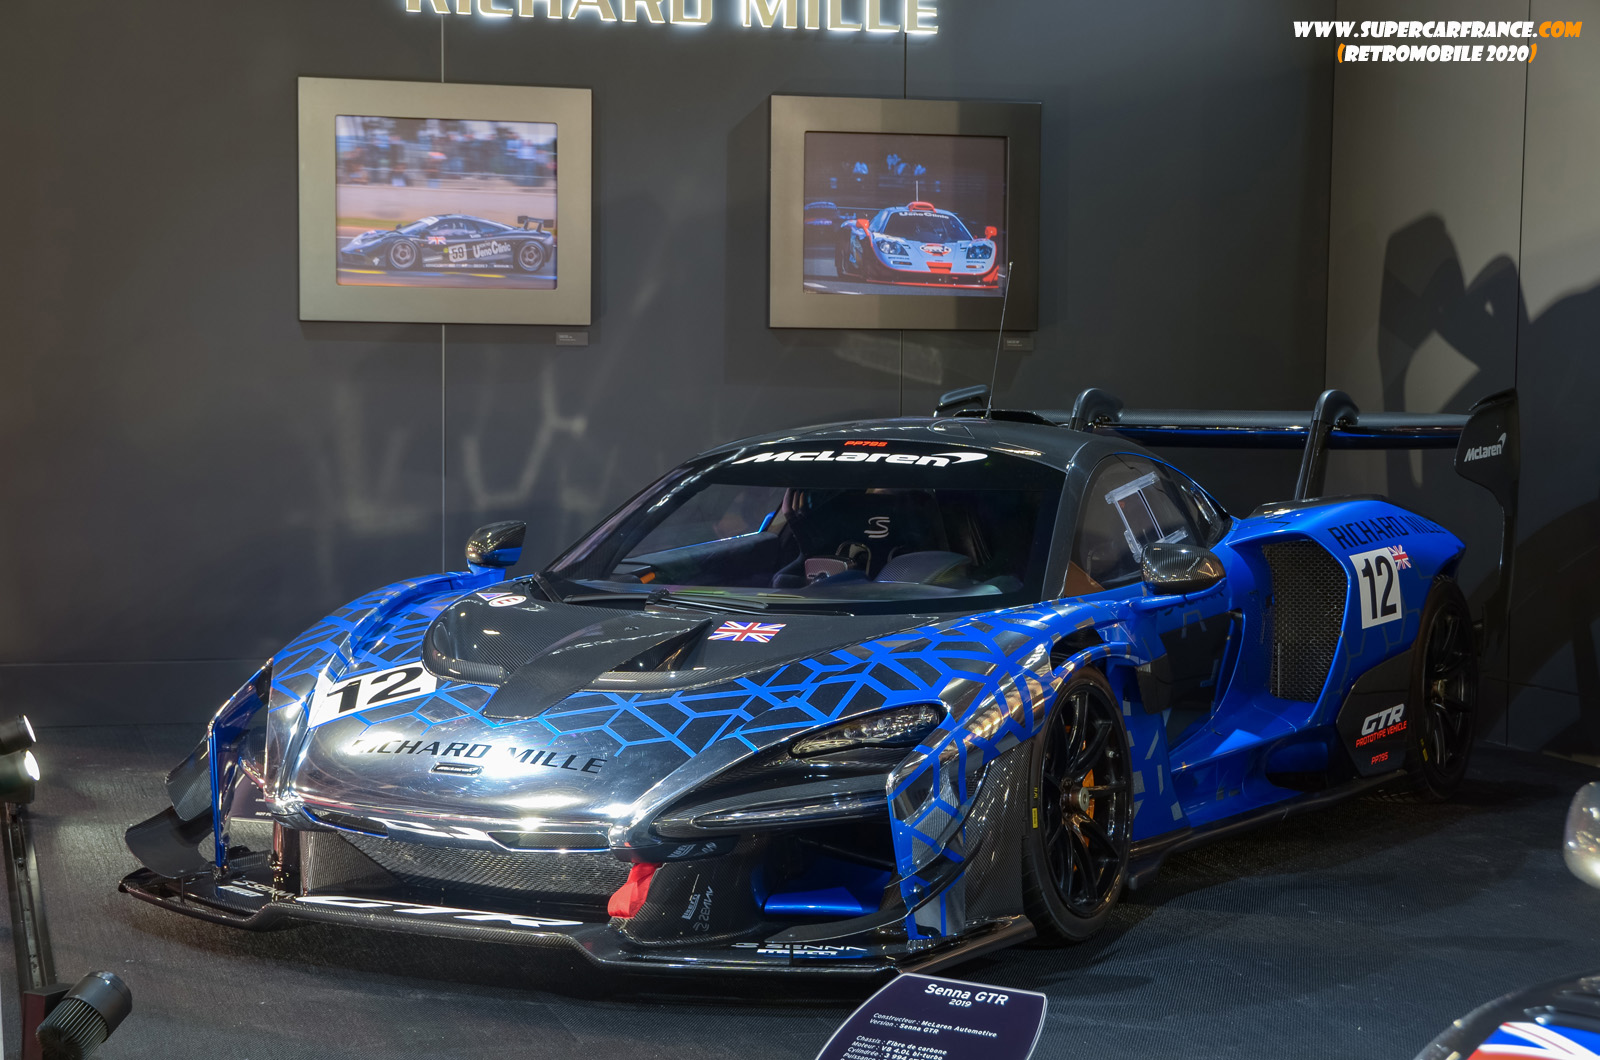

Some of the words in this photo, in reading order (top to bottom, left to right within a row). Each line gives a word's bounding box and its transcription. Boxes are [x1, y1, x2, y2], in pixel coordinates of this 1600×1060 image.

[452, 247, 464, 259] 59
[731, 450, 965, 468] McLaren
[1464, 440, 1503, 462] McLaren
[1328, 516, 1409, 550] RICHARD
[1361, 555, 1397, 620] 12
[327, 666, 424, 713] 12
[1361, 703, 1405, 736] GTR
[1355, 728, 1387, 748] PROTOTYPE
[1386, 720, 1408, 736] VEHICLE
[924, 983, 972, 1000] Senna
[974, 991, 1009, 1006] GTR
[948, 998, 972, 1007] 2019
[869, 1018, 894, 1027] Version
[899, 1023, 921, 1032] Senna
[923, 1027, 940, 1035] GTR
[921, 1020, 952, 1030] McLaren
[953, 1025, 998, 1038] Automotive
[851, 1041, 876, 1049] Moteur
[893, 1048, 911, 1056] 4.0L
[911, 1051, 943, 1060] bi-turbo
[856, 1035, 881, 1045] Chassis
[886, 1039, 906, 1048] Fibre
[917, 1046, 948, 1055] carbone
